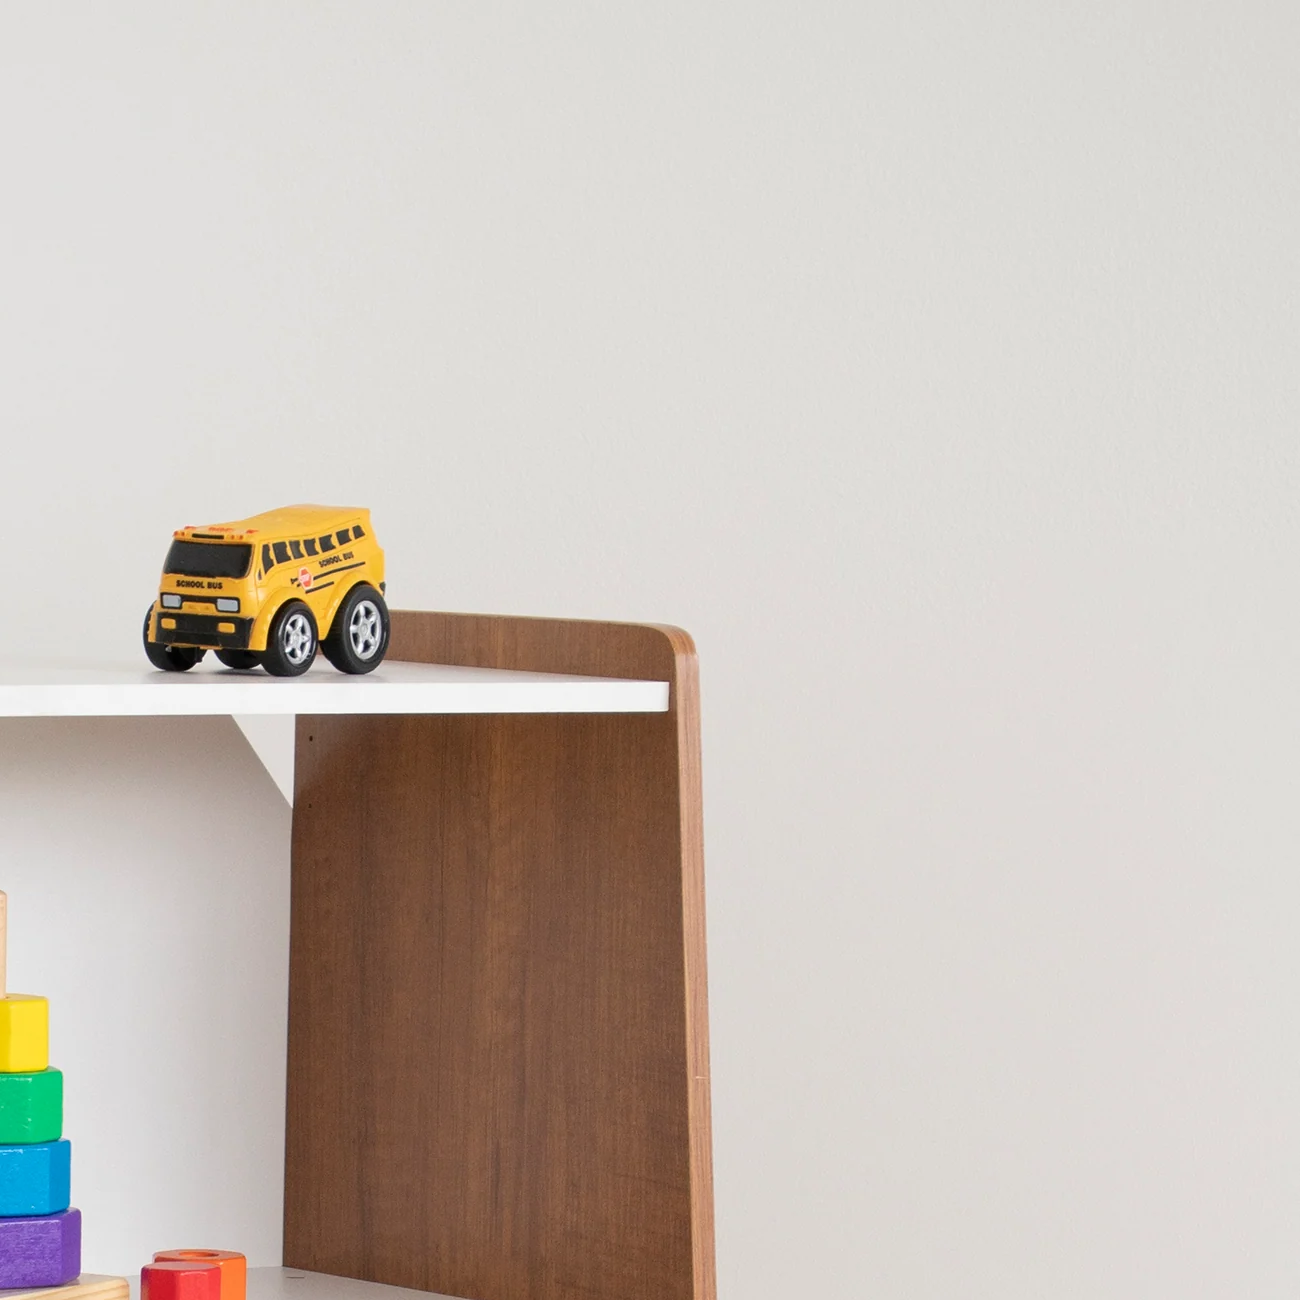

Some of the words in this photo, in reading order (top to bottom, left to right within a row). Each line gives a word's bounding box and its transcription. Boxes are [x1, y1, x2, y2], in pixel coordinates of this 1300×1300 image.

[319, 556, 342, 568] SCHOOL
[343, 551, 354, 561] BUS
[176, 579, 205, 589] SCHOOL
[207, 581, 223, 590] BUS
